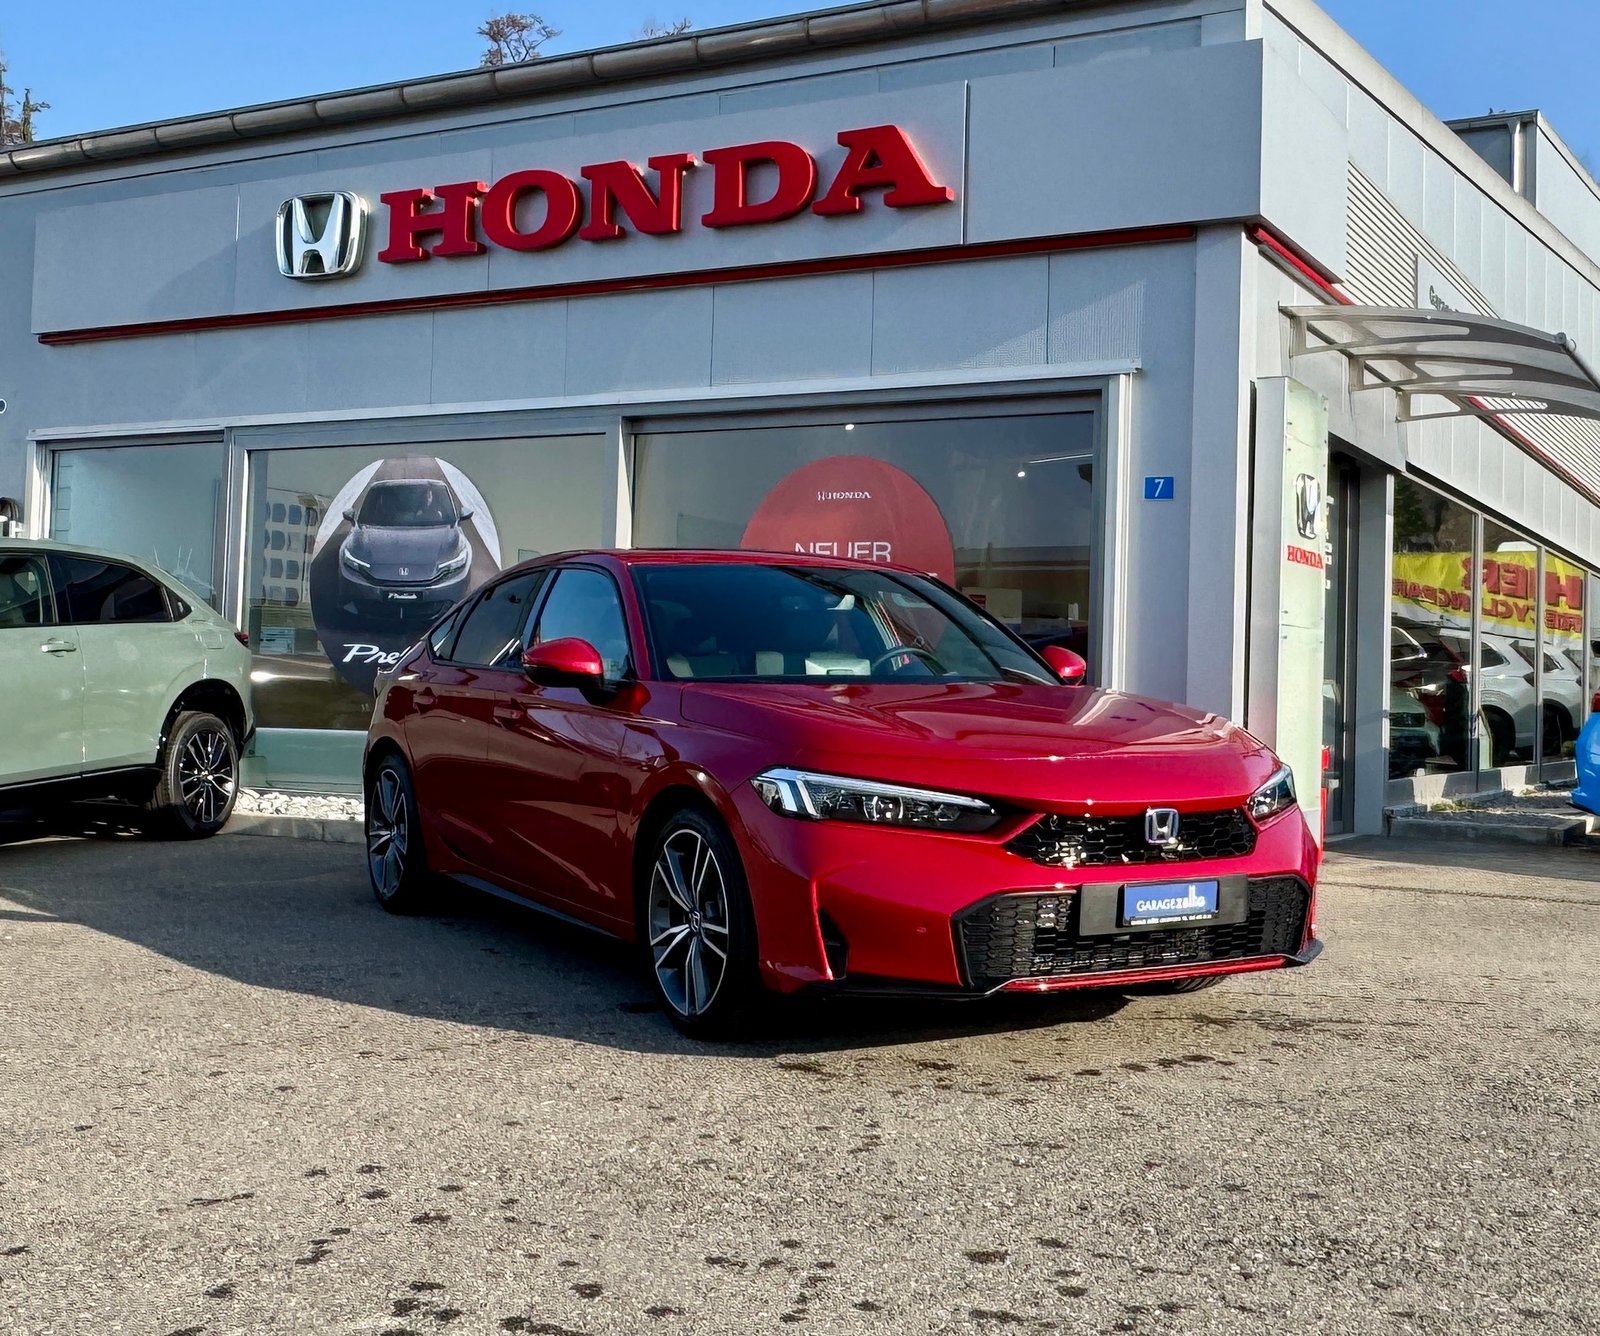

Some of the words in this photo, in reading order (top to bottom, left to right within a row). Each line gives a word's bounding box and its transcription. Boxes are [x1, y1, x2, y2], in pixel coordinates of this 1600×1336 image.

[378, 124, 954, 264] HONDA
[1154, 478, 1165, 498] 7
[1286, 545, 1324, 570] HONDA
[342, 643, 411, 664] Pre
